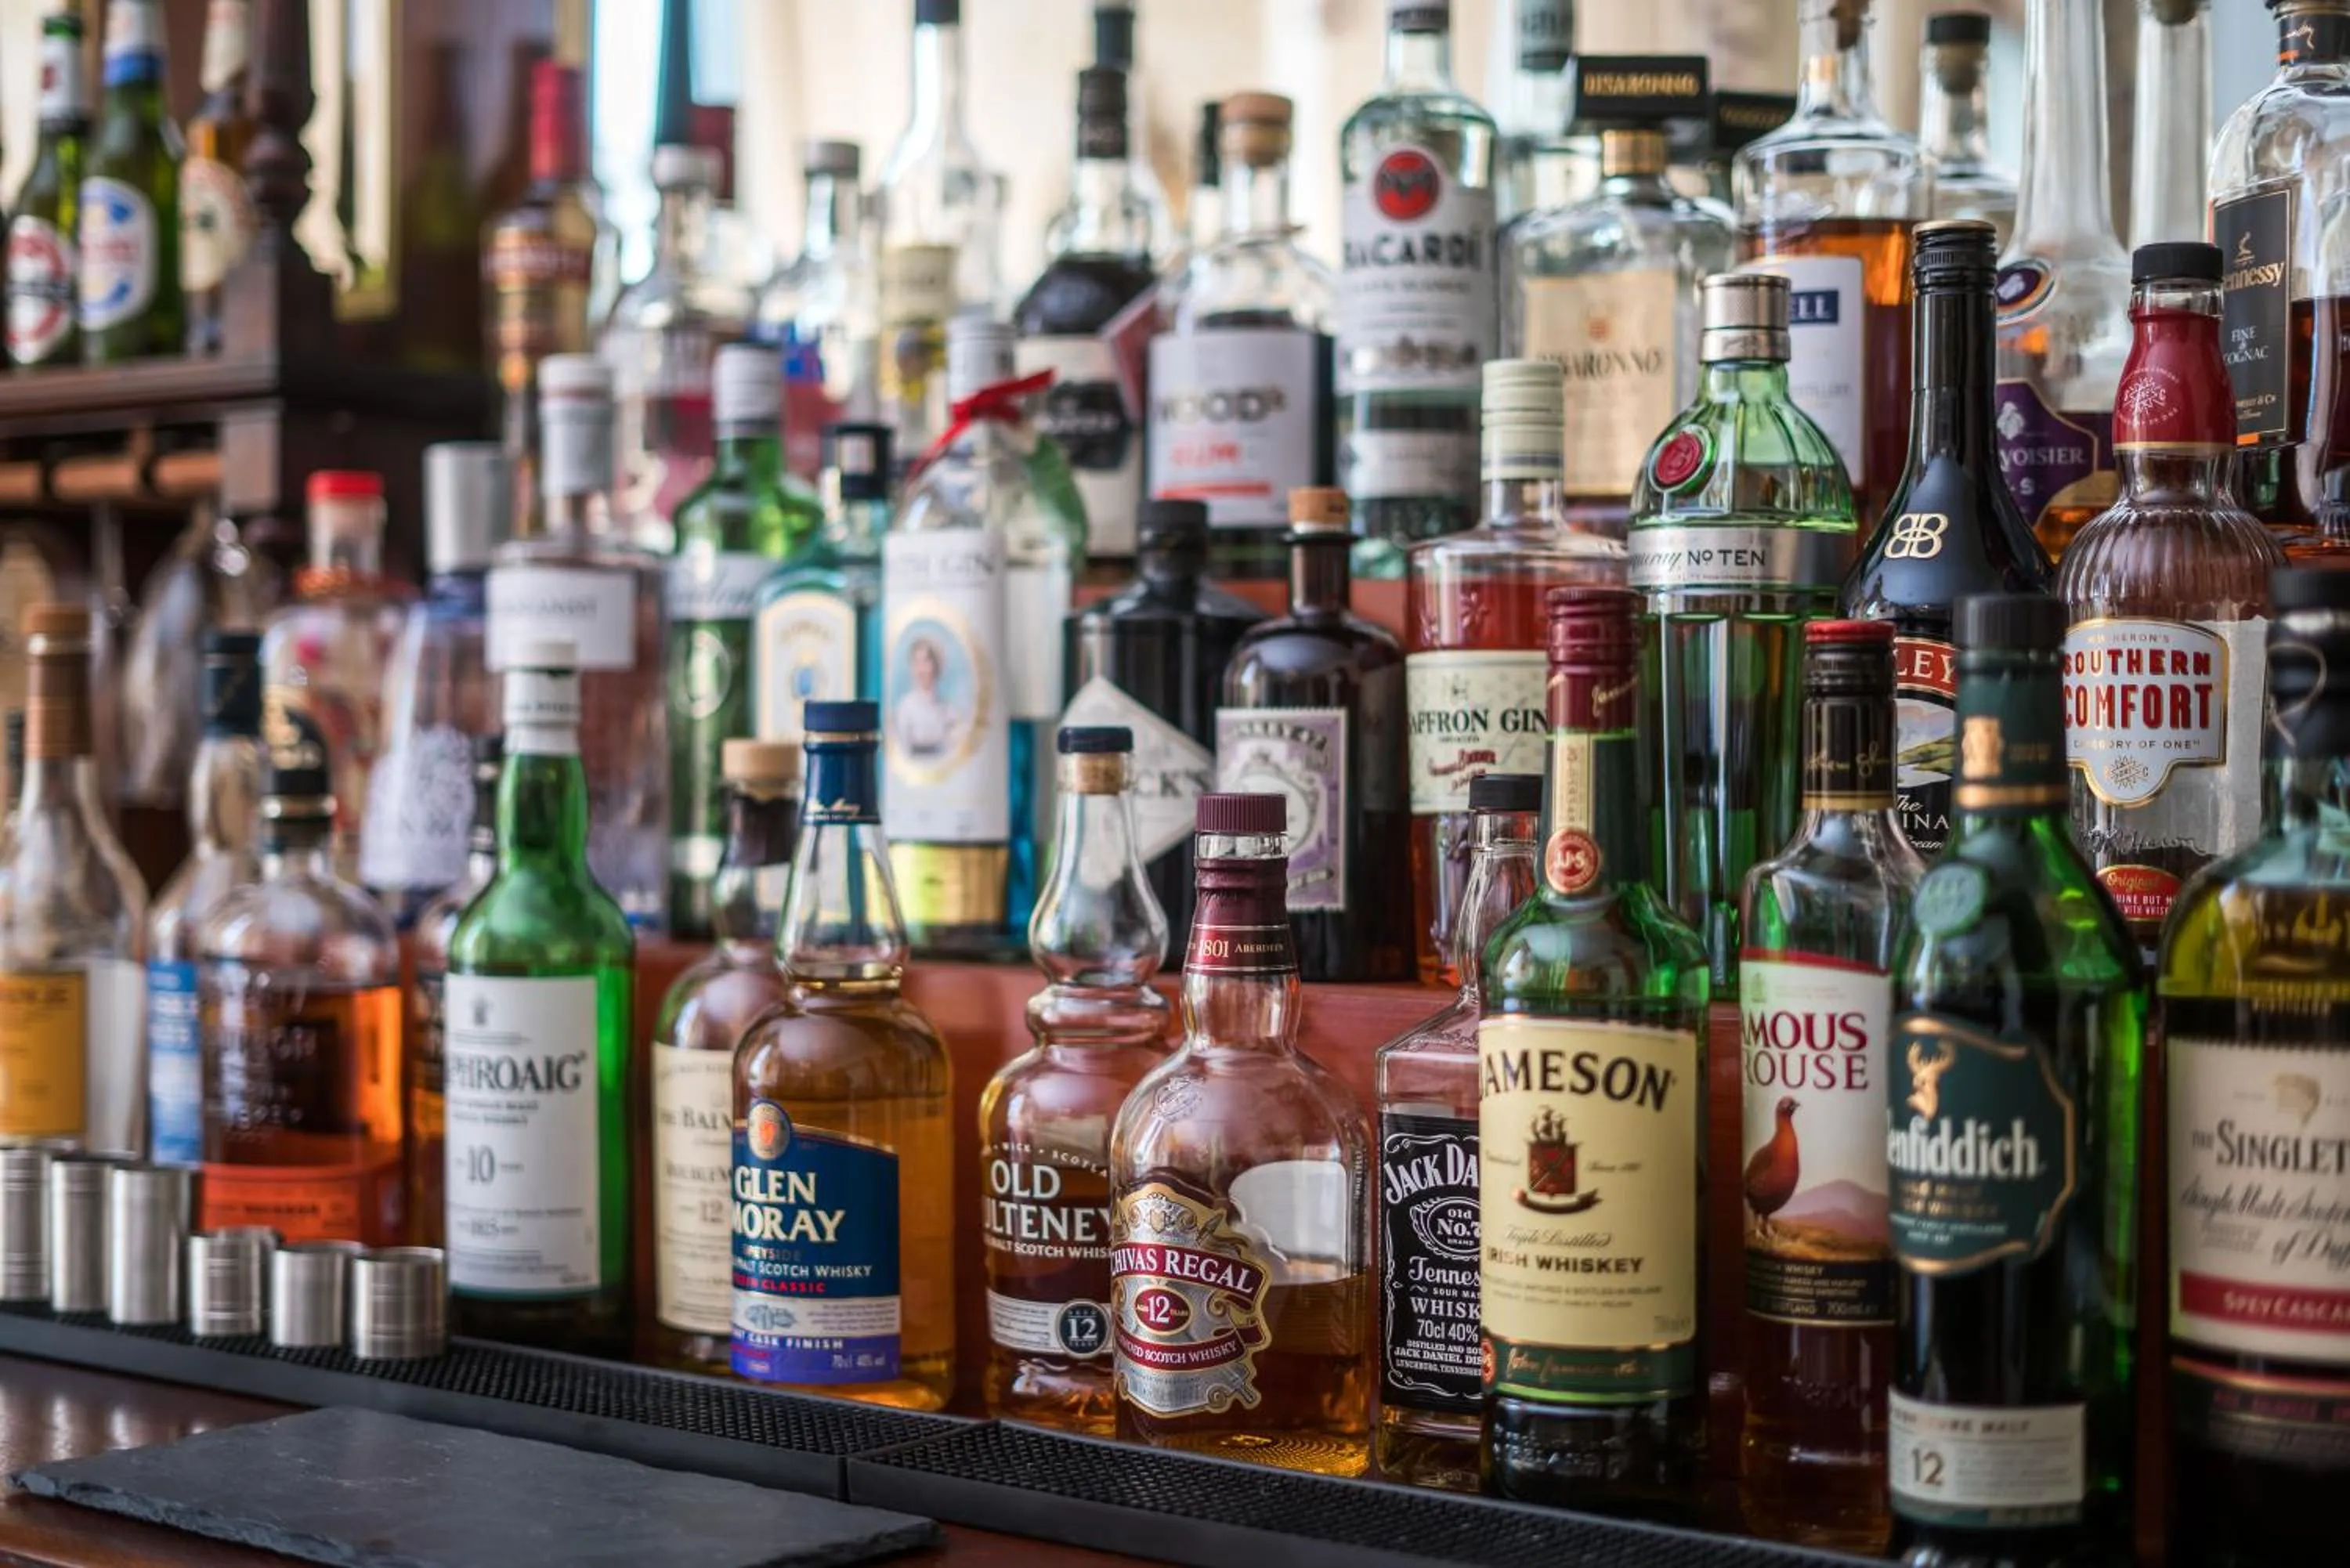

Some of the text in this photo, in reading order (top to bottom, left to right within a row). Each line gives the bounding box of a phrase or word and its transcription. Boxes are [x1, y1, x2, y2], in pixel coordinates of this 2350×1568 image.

[2231, 325, 2257, 342] FINE
[1716, 549, 1766, 566] TEN
[2063, 648, 2211, 677] SOUTHERN
[2063, 683, 2214, 729] COMFORT
[2138, 740, 2156, 750] OF
[1198, 940, 1229, 958] 1801
[467, 1146, 496, 1184] 10
[735, 1165, 816, 1204] GLEN
[991, 1159, 1061, 1199] OLD
[1383, 1154, 1443, 1204] JACK
[1448, 1209, 1472, 1219] Old
[1014, 1242, 1065, 1258] SCOTCH
[759, 1262, 810, 1279] SCOTCH
[814, 1264, 873, 1279] WHISKY
[1165, 1249, 1253, 1293] REGAL
[1535, 1255, 1645, 1274] WHISKEY
[762, 1277, 826, 1293] CLASSIC
[1433, 1287, 1458, 1298] SOUR
[1147, 1296, 1170, 1324] 12
[2223, 1290, 2350, 1324] SPEYCASCA
[1068, 1318, 1097, 1339] 12
[1417, 1318, 1479, 1344] 70cl 40%
[786, 1337, 844, 1350] FINISH
[1144, 1350, 1186, 1364] SCOTCH
[1189, 1340, 1237, 1361] WHISKY
[1407, 1339, 1445, 1352] DISTILLED
[1448, 1345, 1464, 1354] AND
[1394, 1346, 1421, 1357] JACK
[1423, 1349, 1462, 1364] DANIEL
[1912, 1448, 1944, 1487] 12
